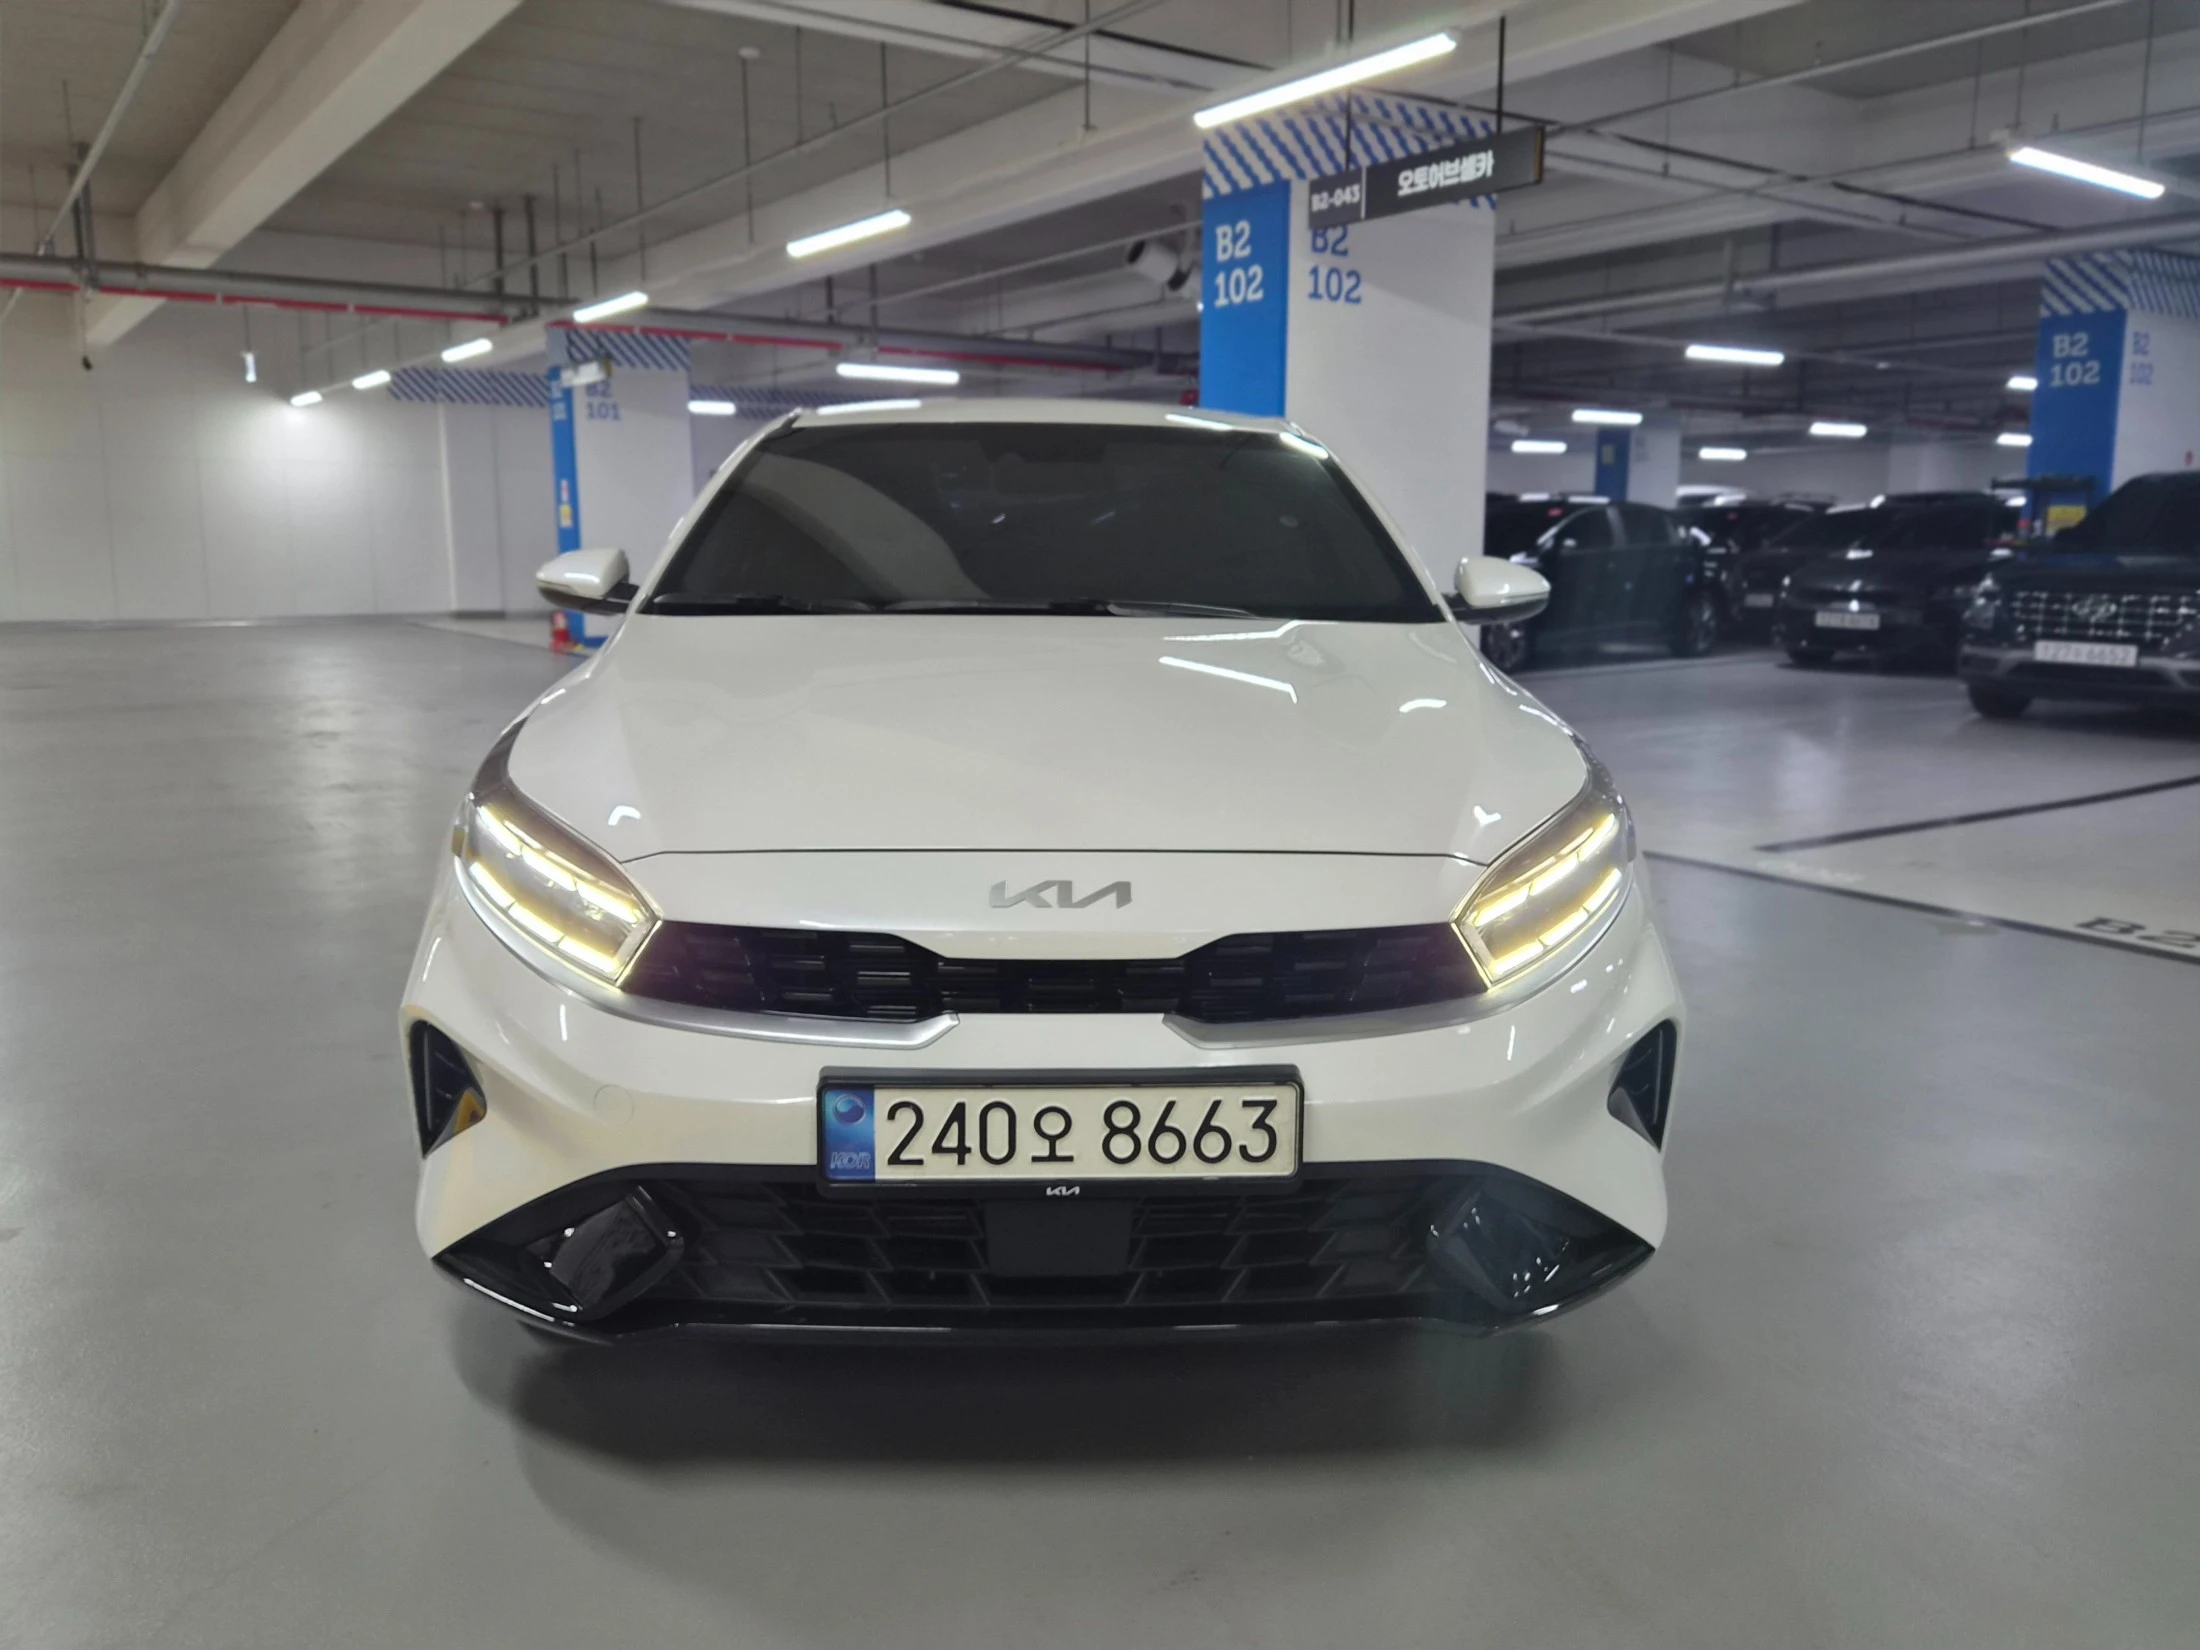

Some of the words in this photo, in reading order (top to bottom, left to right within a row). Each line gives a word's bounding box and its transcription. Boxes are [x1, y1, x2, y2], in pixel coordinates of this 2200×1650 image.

[1311, 183, 1361, 213] B2-043
[1215, 220, 1251, 262] B2
[1311, 225, 1349, 257] B2
[1214, 264, 1264, 308] 102
[1308, 266, 1361, 304] 102
[2053, 332, 2089, 358] B2
[2050, 361, 2100, 387] 102
[586, 402, 621, 420] 101
[988, 879, 1132, 909] KIA
[887, 1101, 1074, 1166] 240오
[1101, 1099, 1278, 1165] 8663
[830, 1151, 871, 1170] KOR
[1045, 1185, 1080, 1196] KIA
